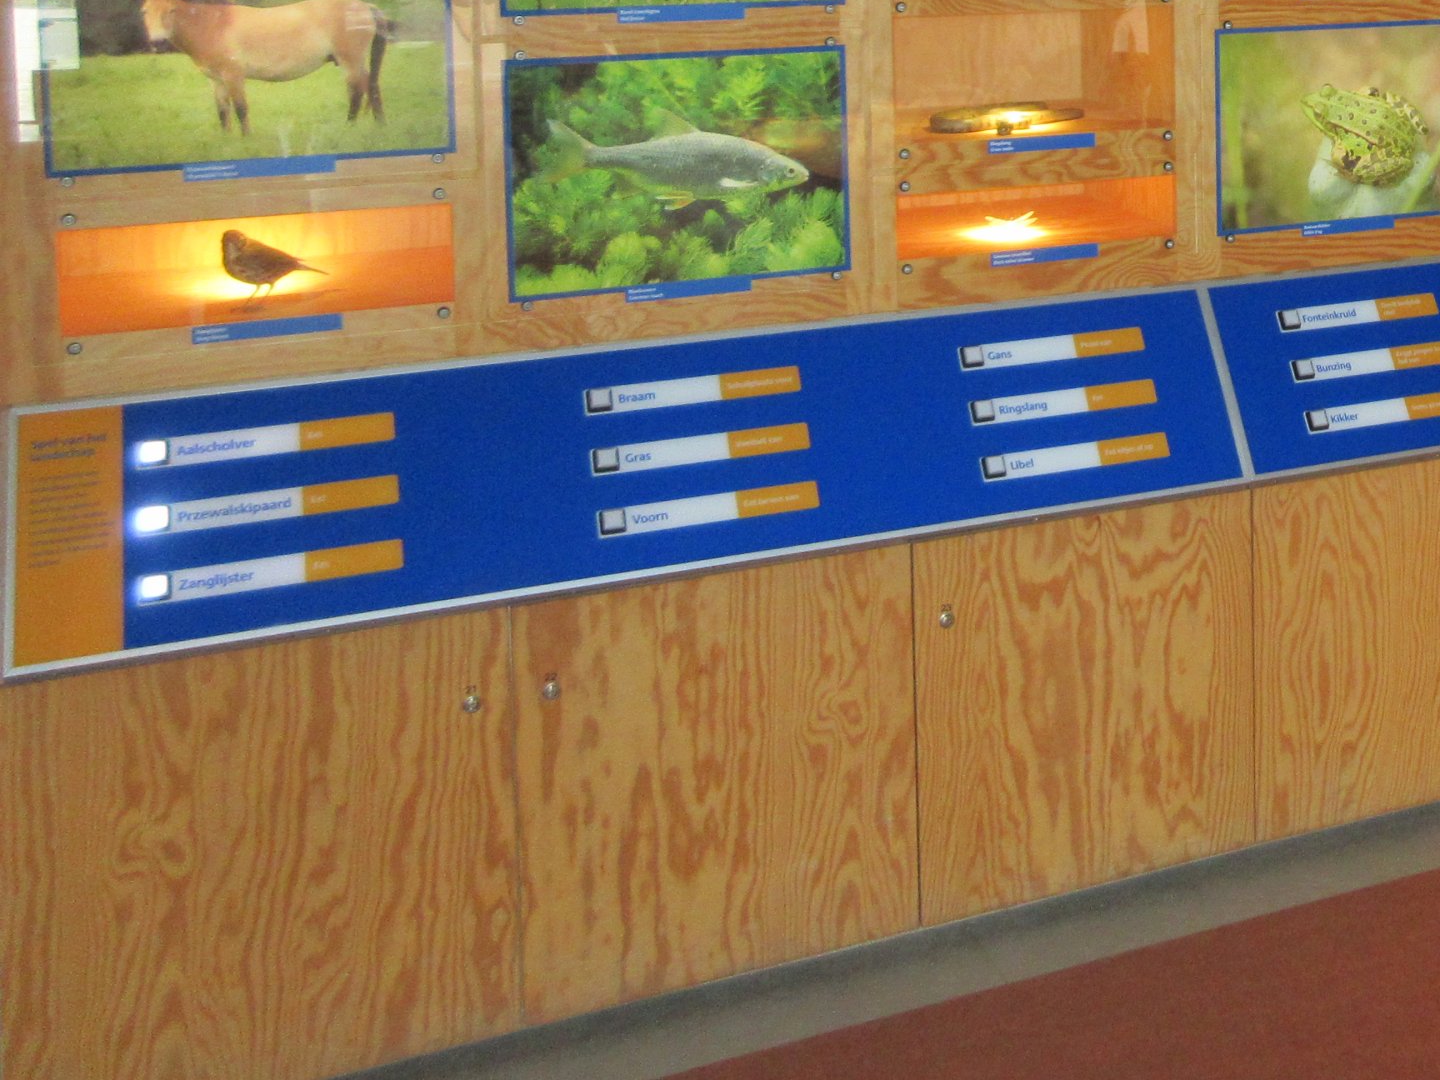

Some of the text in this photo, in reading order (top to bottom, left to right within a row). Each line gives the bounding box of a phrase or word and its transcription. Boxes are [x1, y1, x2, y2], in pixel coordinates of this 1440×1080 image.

[1302, 308, 1357, 324] Fonteinkruid
[988, 349, 1013, 361] Gans
[1316, 360, 1352, 374] Bunzing
[618, 390, 656, 404] Braam
[998, 400, 1048, 416] Ringslang
[1330, 412, 1359, 424] Kikker
[176, 436, 258, 458] Aalscholver
[624, 451, 652, 464] Gras
[1010, 457, 1035, 471] Libel
[176, 496, 293, 523] Przewalskipaard
[632, 510, 669, 525] Voorn
[178, 569, 255, 592] Zanglijster
